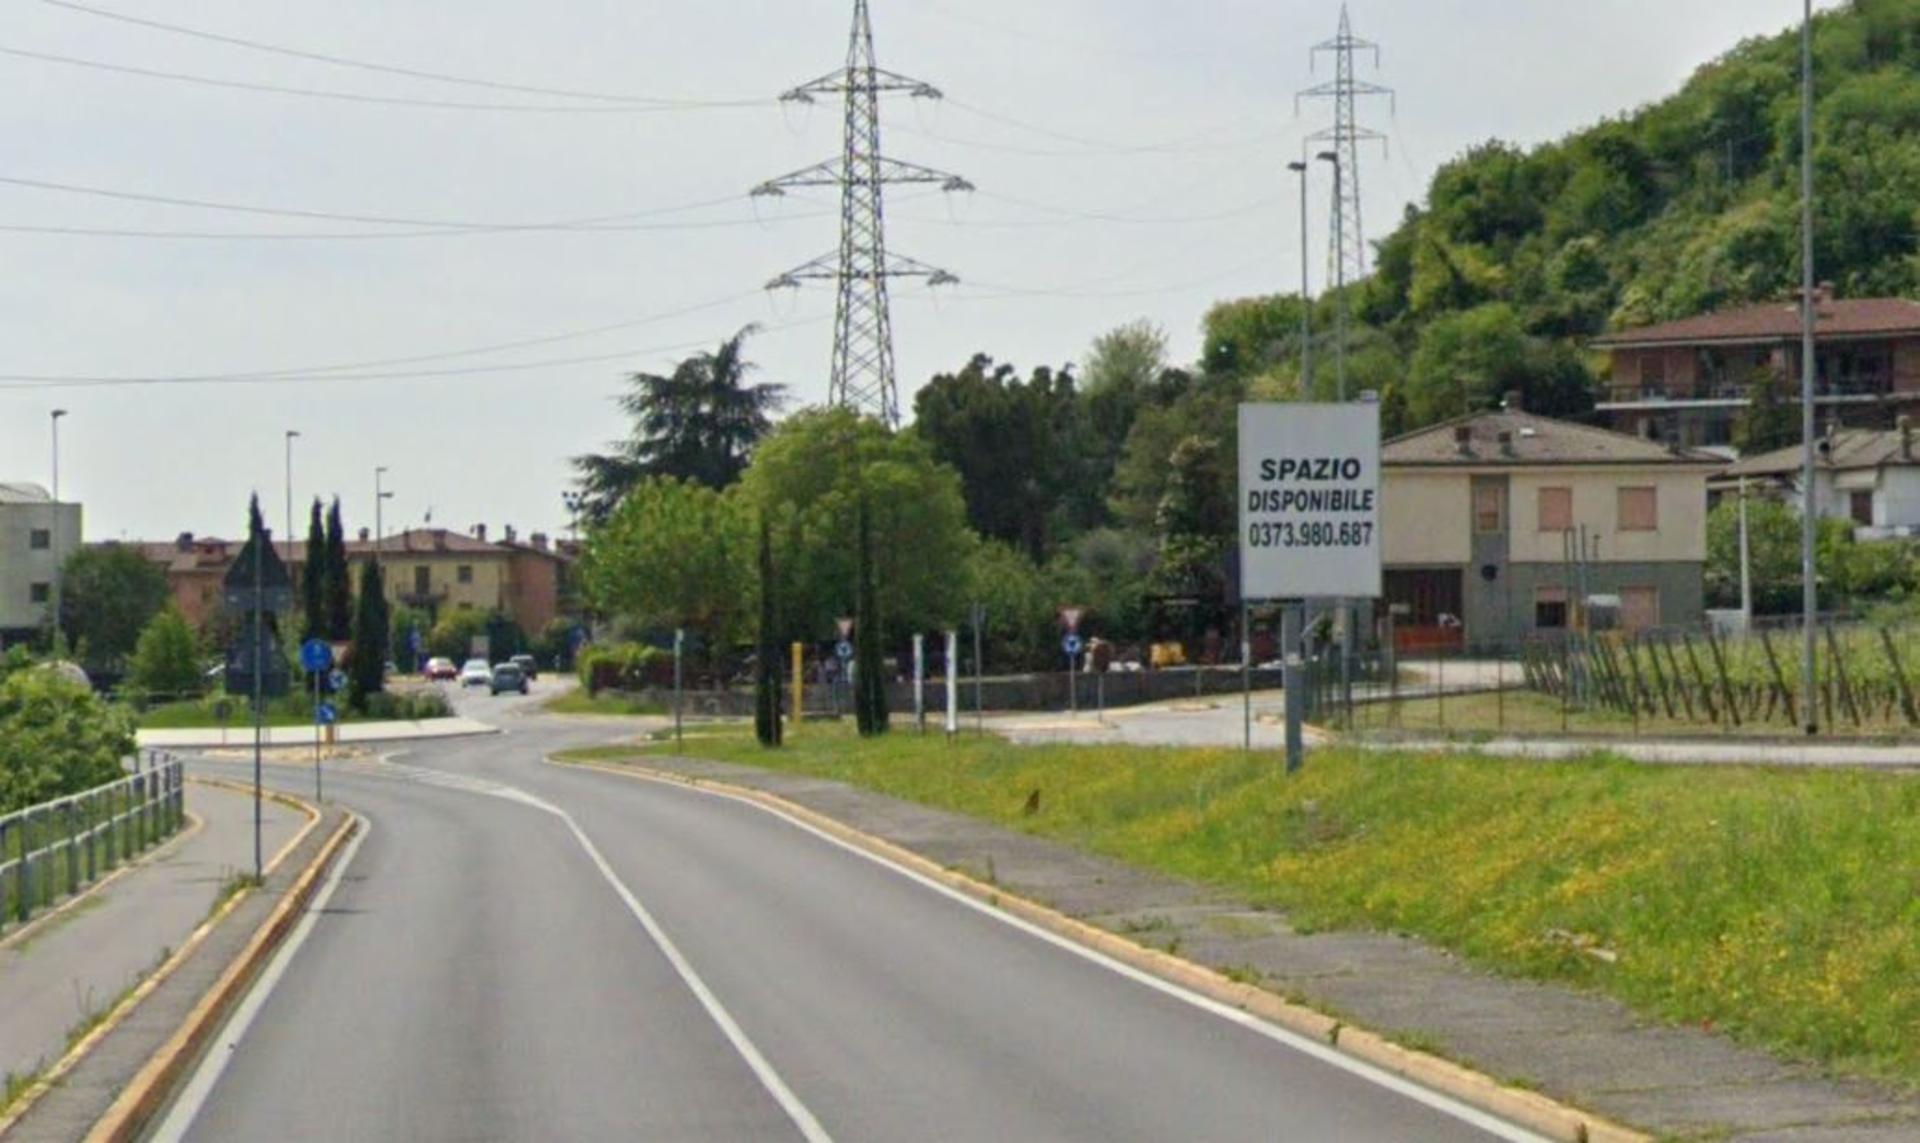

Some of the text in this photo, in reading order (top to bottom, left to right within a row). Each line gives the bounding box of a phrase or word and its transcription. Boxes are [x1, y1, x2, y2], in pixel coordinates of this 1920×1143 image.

[1260, 458, 1361, 480] SPAZIO
[1248, 489, 1374, 512] DISPONIBILE
[1249, 521, 1373, 547] 0373.980.687
